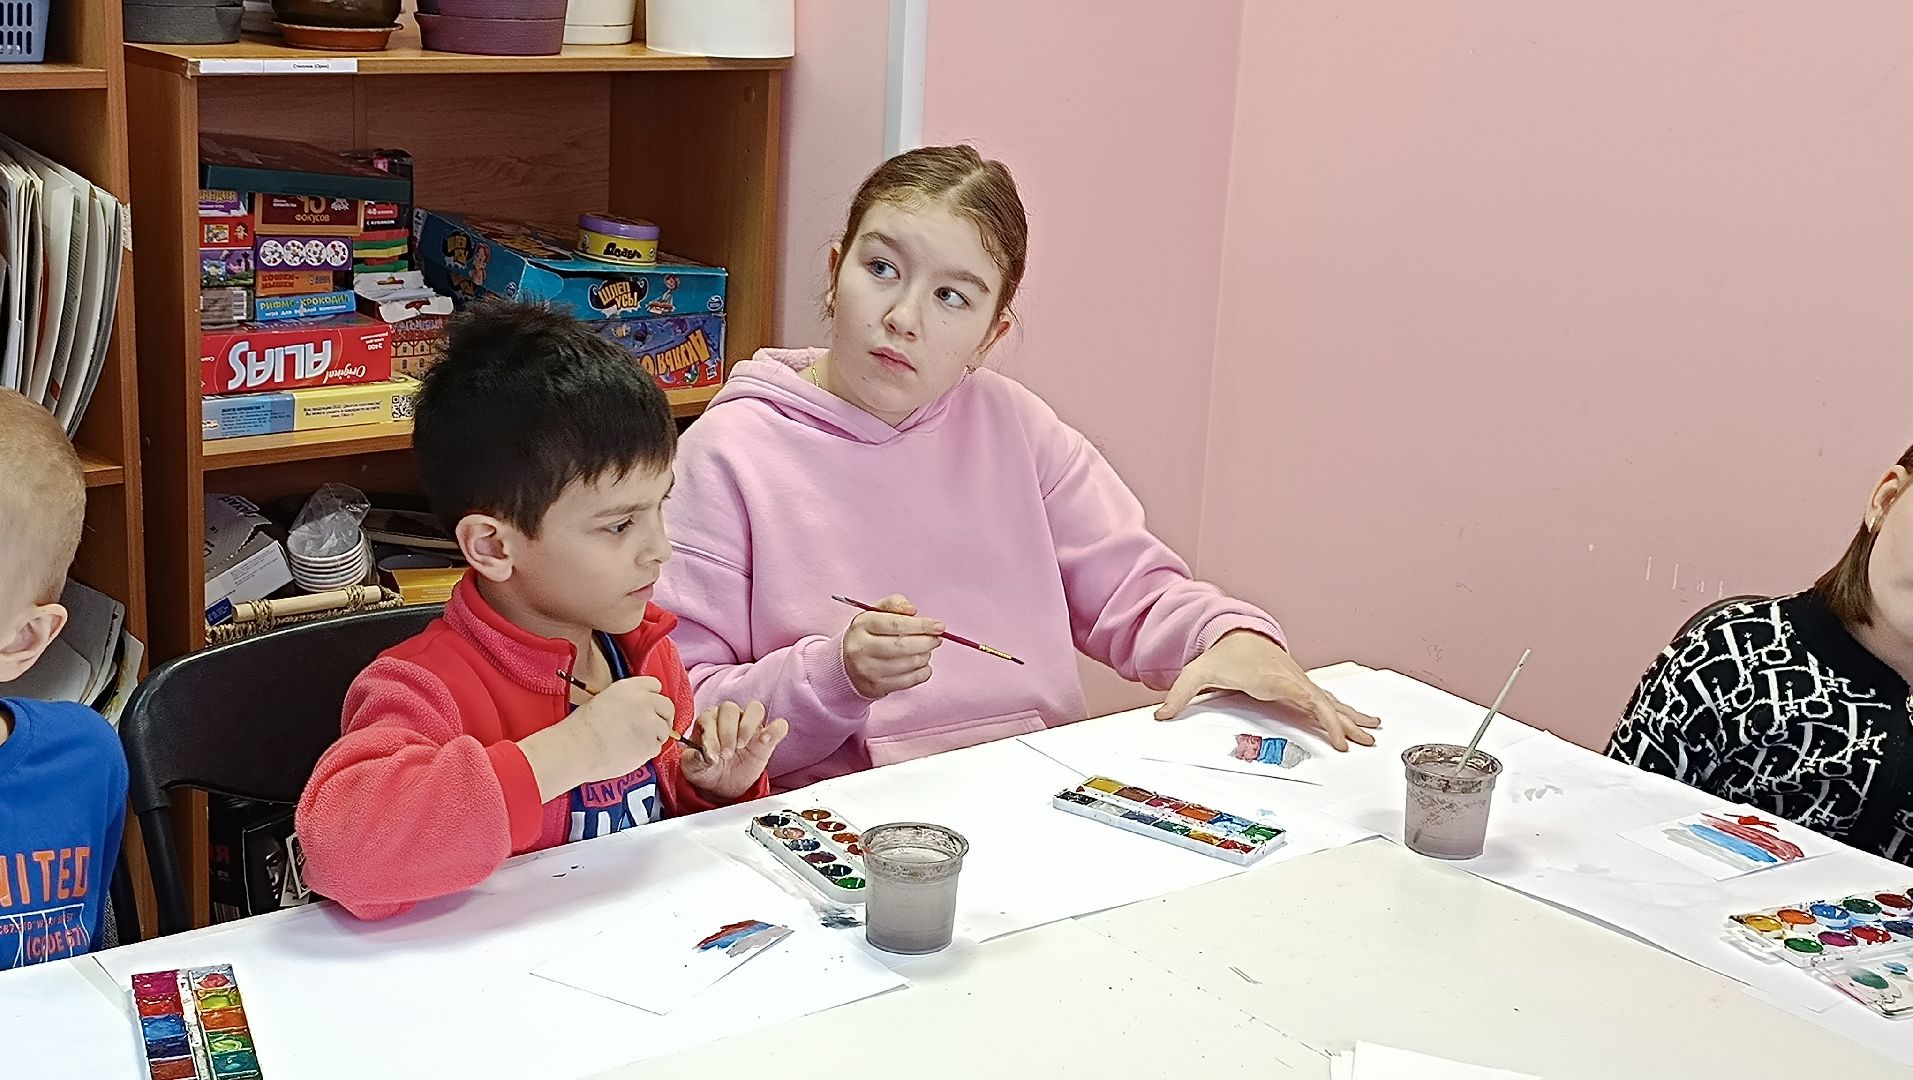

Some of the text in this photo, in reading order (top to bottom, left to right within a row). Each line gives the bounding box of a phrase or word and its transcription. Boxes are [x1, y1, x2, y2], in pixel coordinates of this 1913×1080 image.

[295, 214, 330, 223] ФОКУСОВ
[598, 281, 631, 306] ШЛЕП
[615, 291, 638, 308] УСЫ
[657, 329, 711, 375] АКУЛЬЯ
[228, 339, 332, 390] ALIAS
[322, 362, 366, 384] Original
